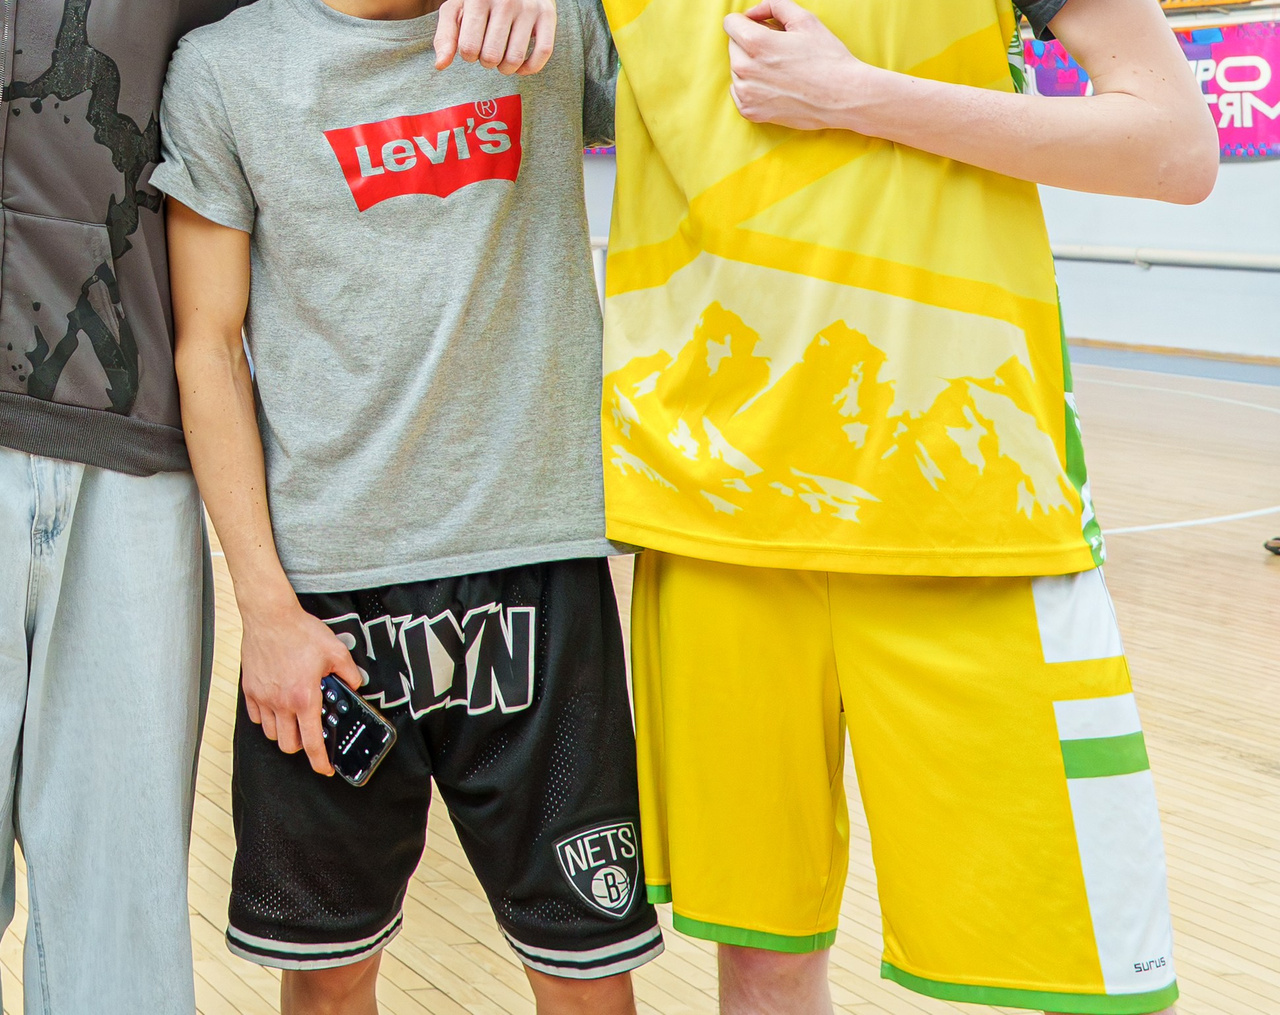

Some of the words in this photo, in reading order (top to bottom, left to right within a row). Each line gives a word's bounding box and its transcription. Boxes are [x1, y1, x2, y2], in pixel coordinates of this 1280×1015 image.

[564, 827, 636, 877] NETS
[603, 871, 621, 903] B
[1133, 956, 1166, 973] surus
